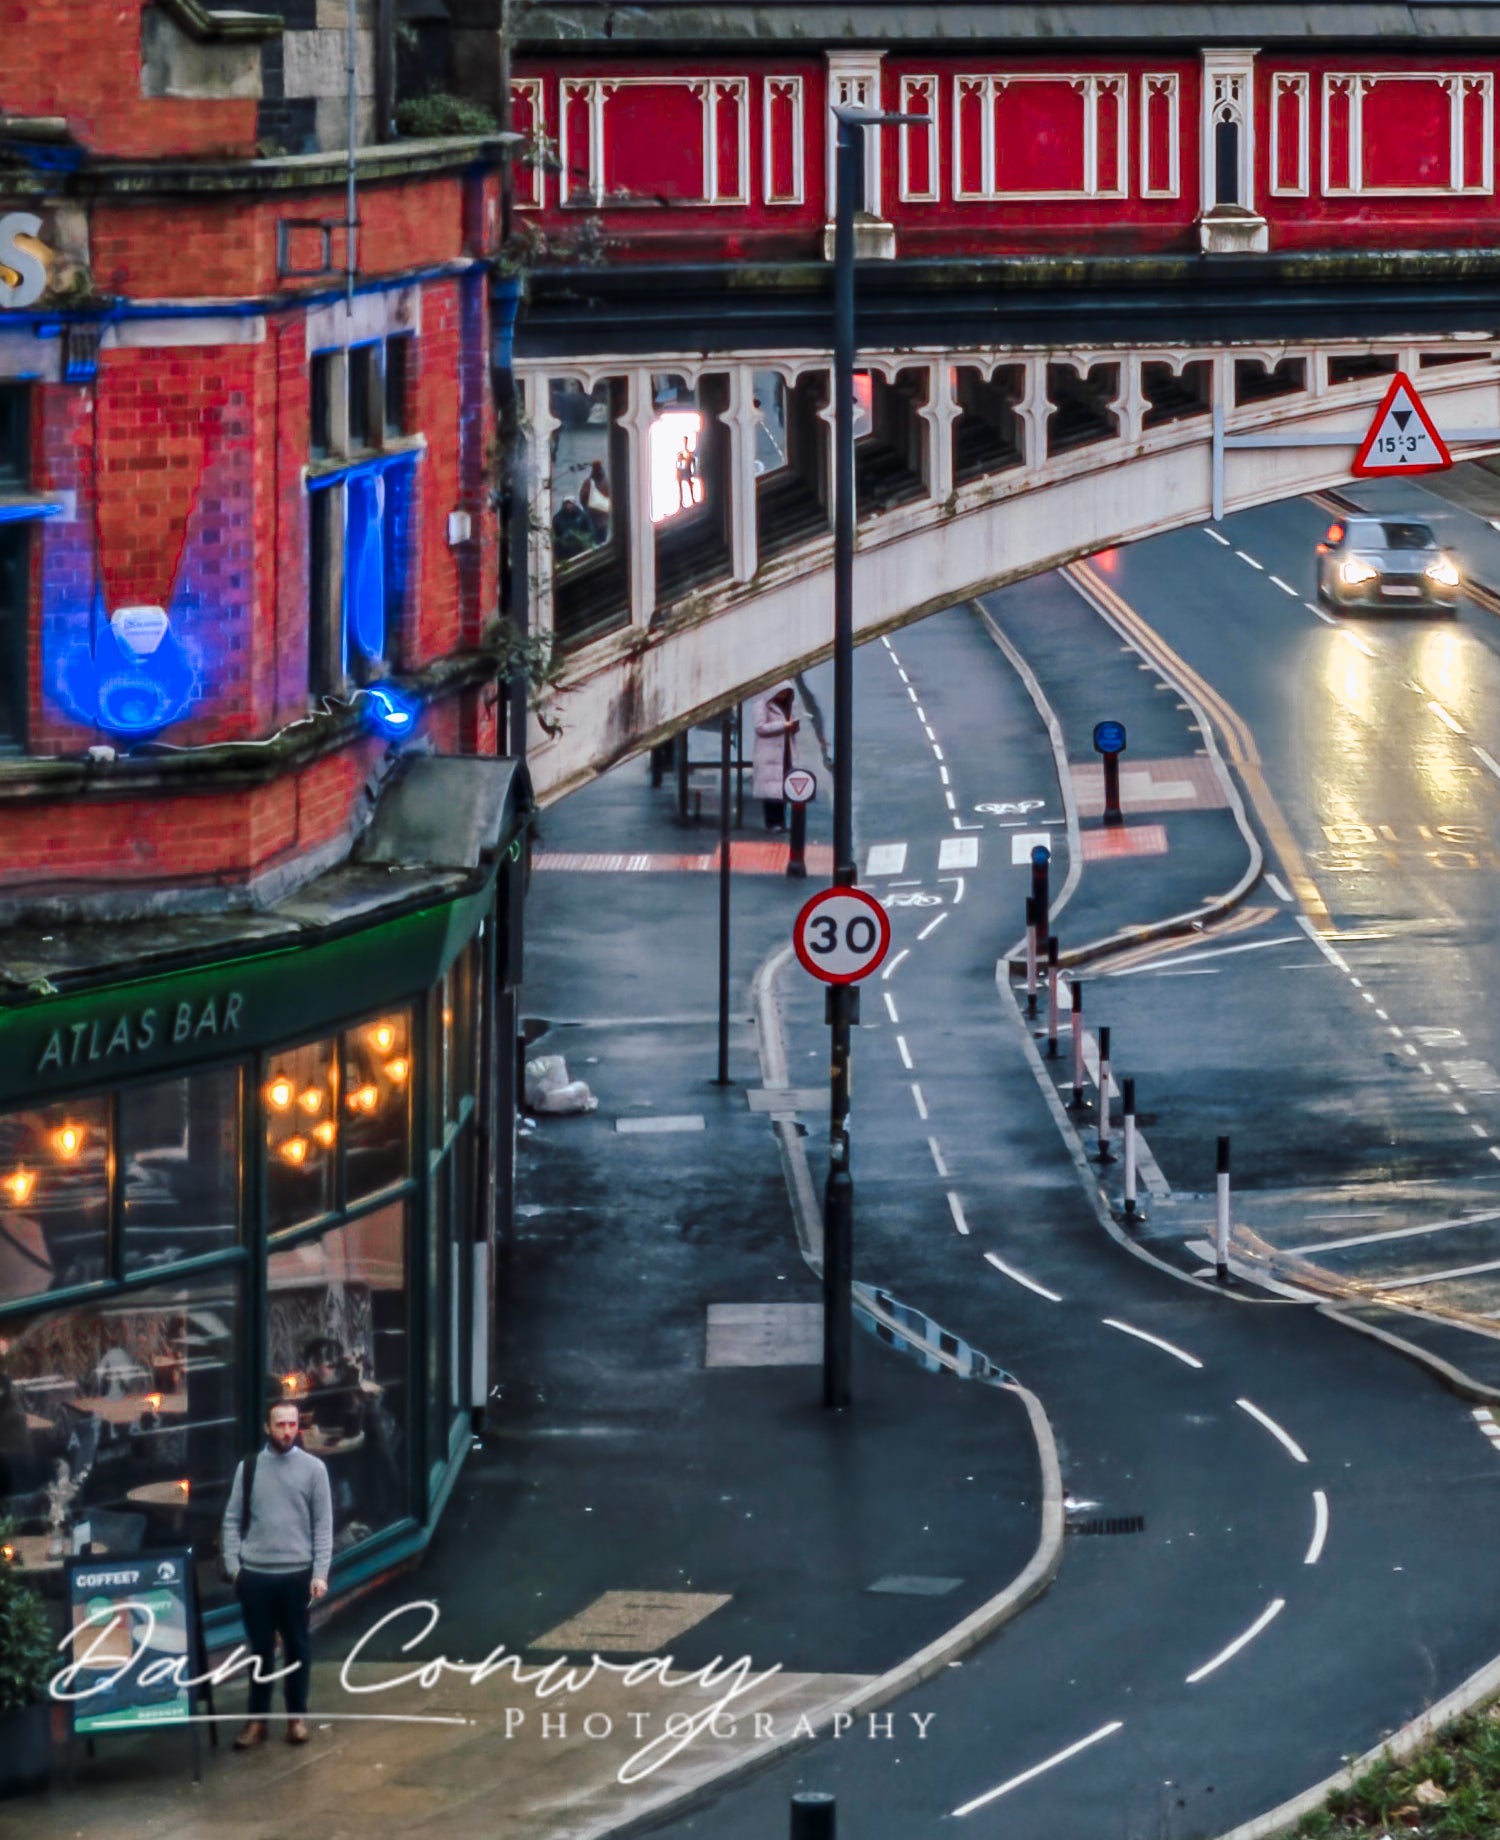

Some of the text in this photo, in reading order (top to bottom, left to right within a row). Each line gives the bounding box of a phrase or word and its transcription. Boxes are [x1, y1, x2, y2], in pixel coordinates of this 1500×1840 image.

[809, 915, 876, 954] 30
[37, 992, 243, 1072] ATLAS BAR
[76, 1570, 140, 1588] COFFEE?
